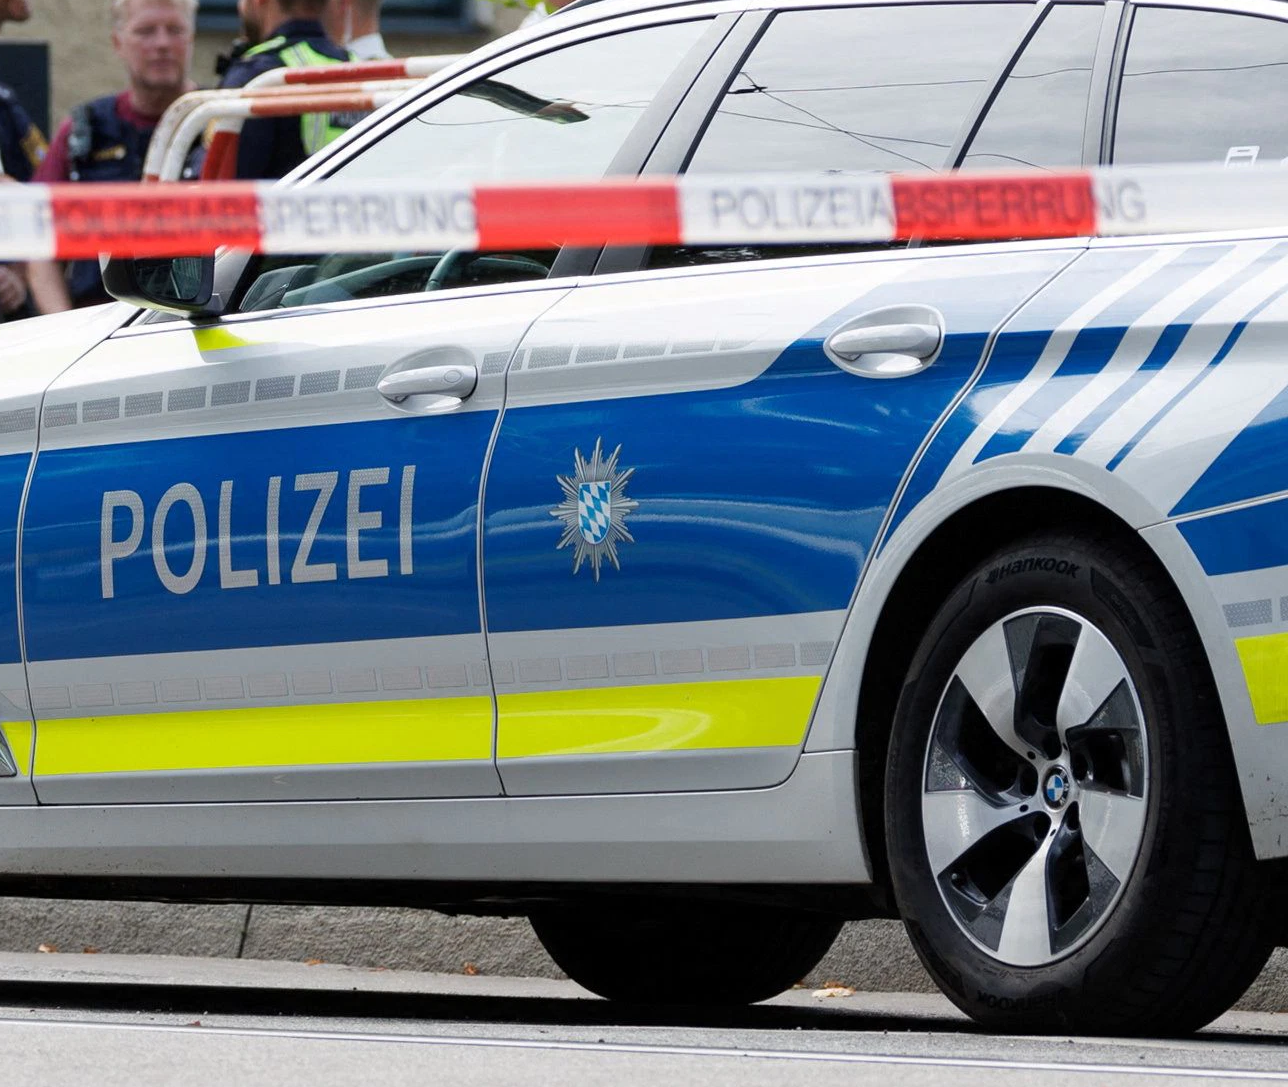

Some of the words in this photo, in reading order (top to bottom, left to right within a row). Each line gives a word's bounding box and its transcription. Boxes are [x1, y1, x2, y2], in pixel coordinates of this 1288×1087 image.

[36, 190, 479, 242] POLIZEIABSPERRUNG
[711, 180, 1147, 228] POLIZEIABSPERRUNG
[100, 464, 417, 599] POLIZEI
